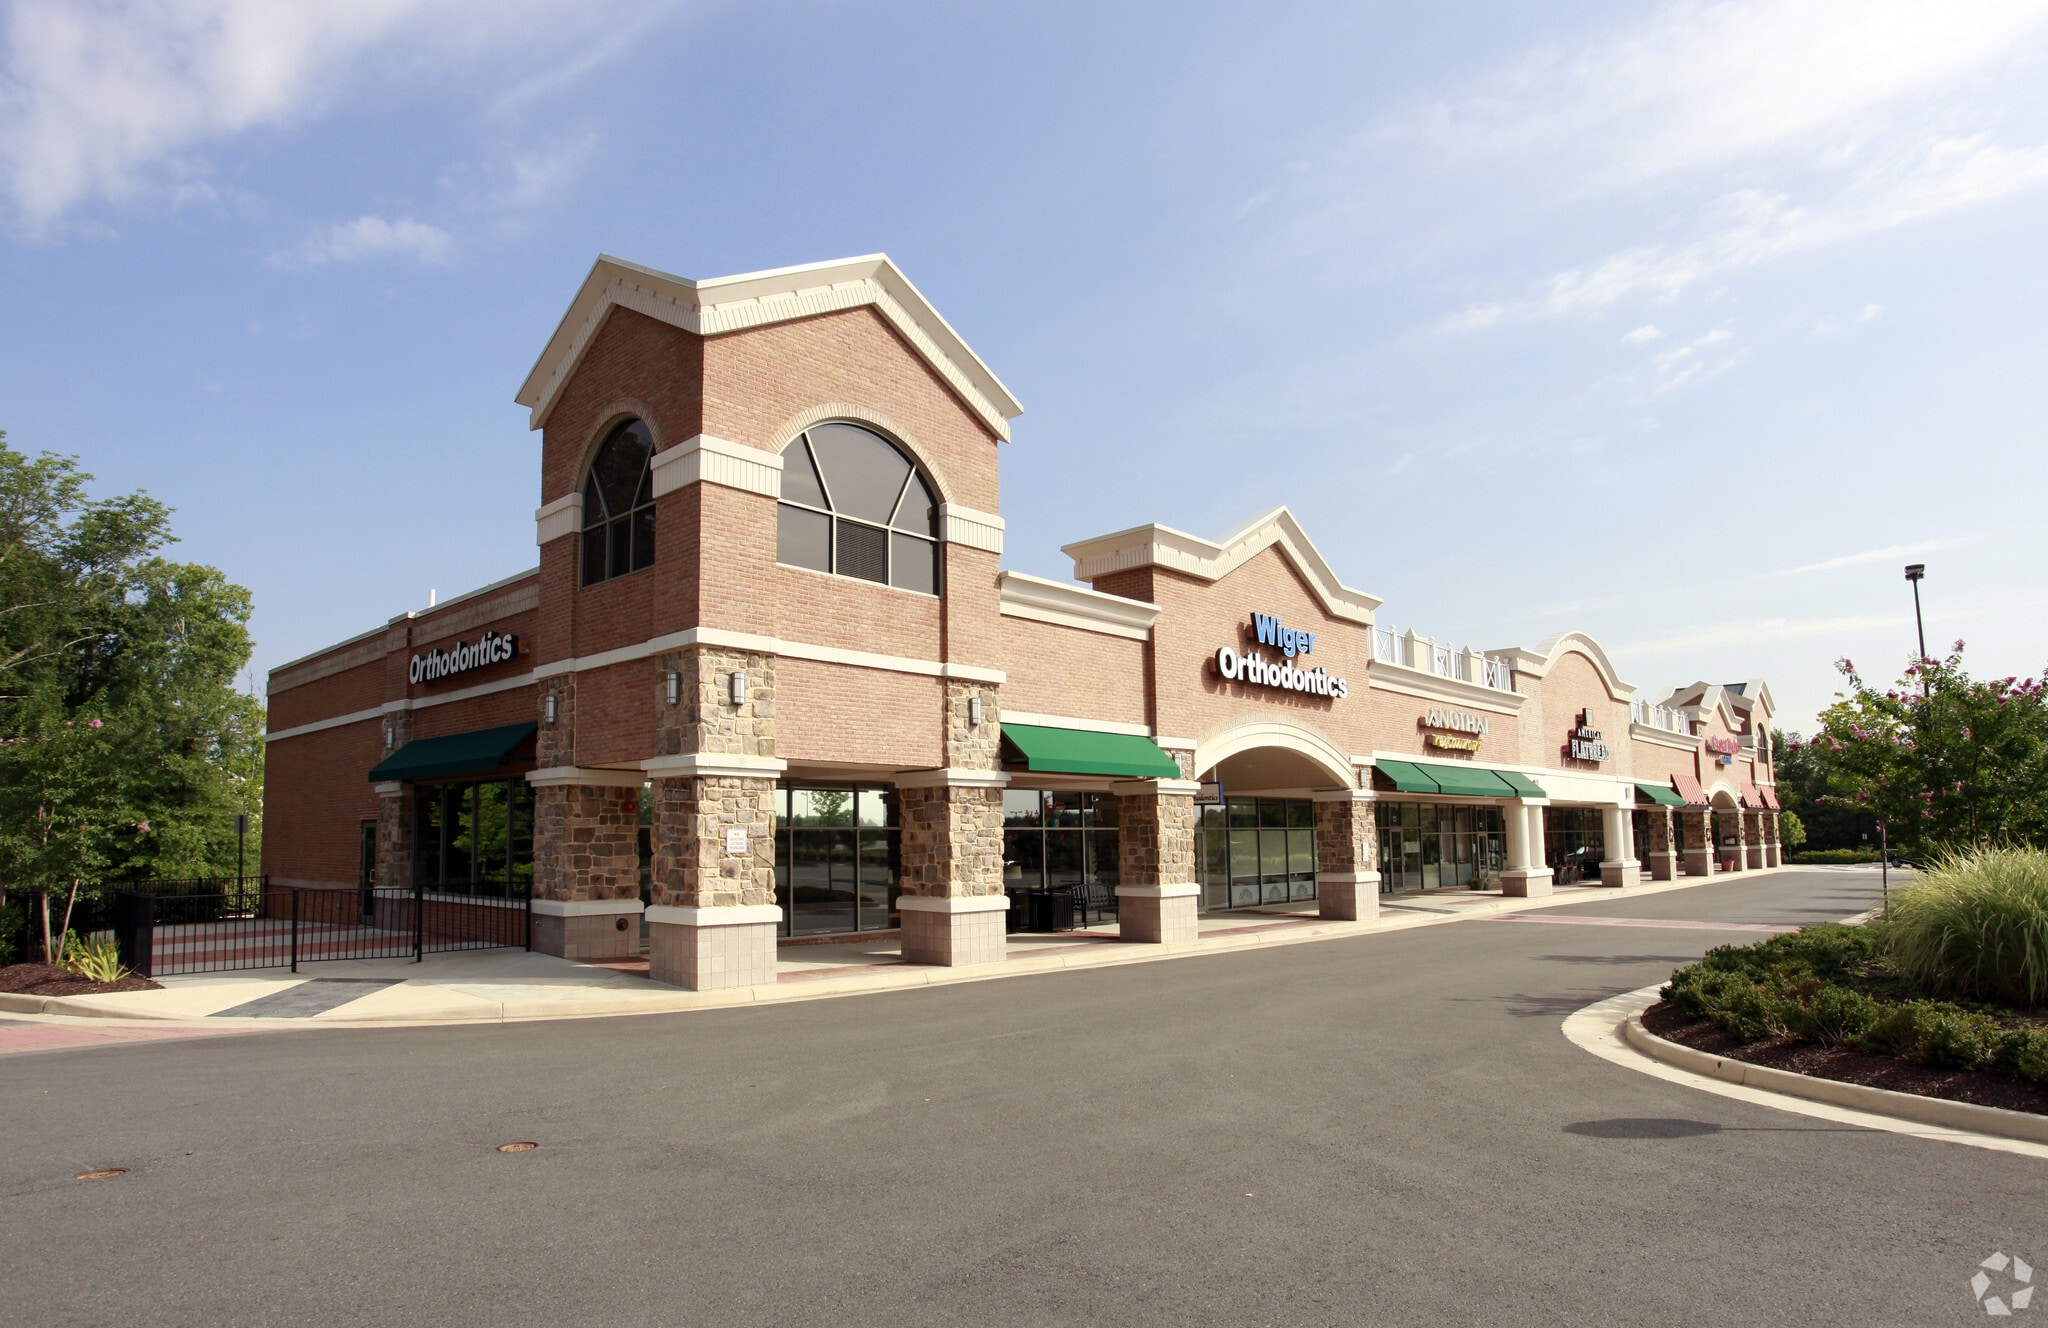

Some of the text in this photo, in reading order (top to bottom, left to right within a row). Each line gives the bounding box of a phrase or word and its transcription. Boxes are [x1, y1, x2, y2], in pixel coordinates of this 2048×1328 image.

[1254, 612, 1317, 657] Wiger
[409, 631, 513, 684] Orthodontics
[1218, 646, 1348, 698] Orthodontics
[1427, 707, 1489, 735] ANOTHAI
[1578, 728, 1605, 740] AMERICAN
[1571, 739, 1611, 762] FLATBREAD
